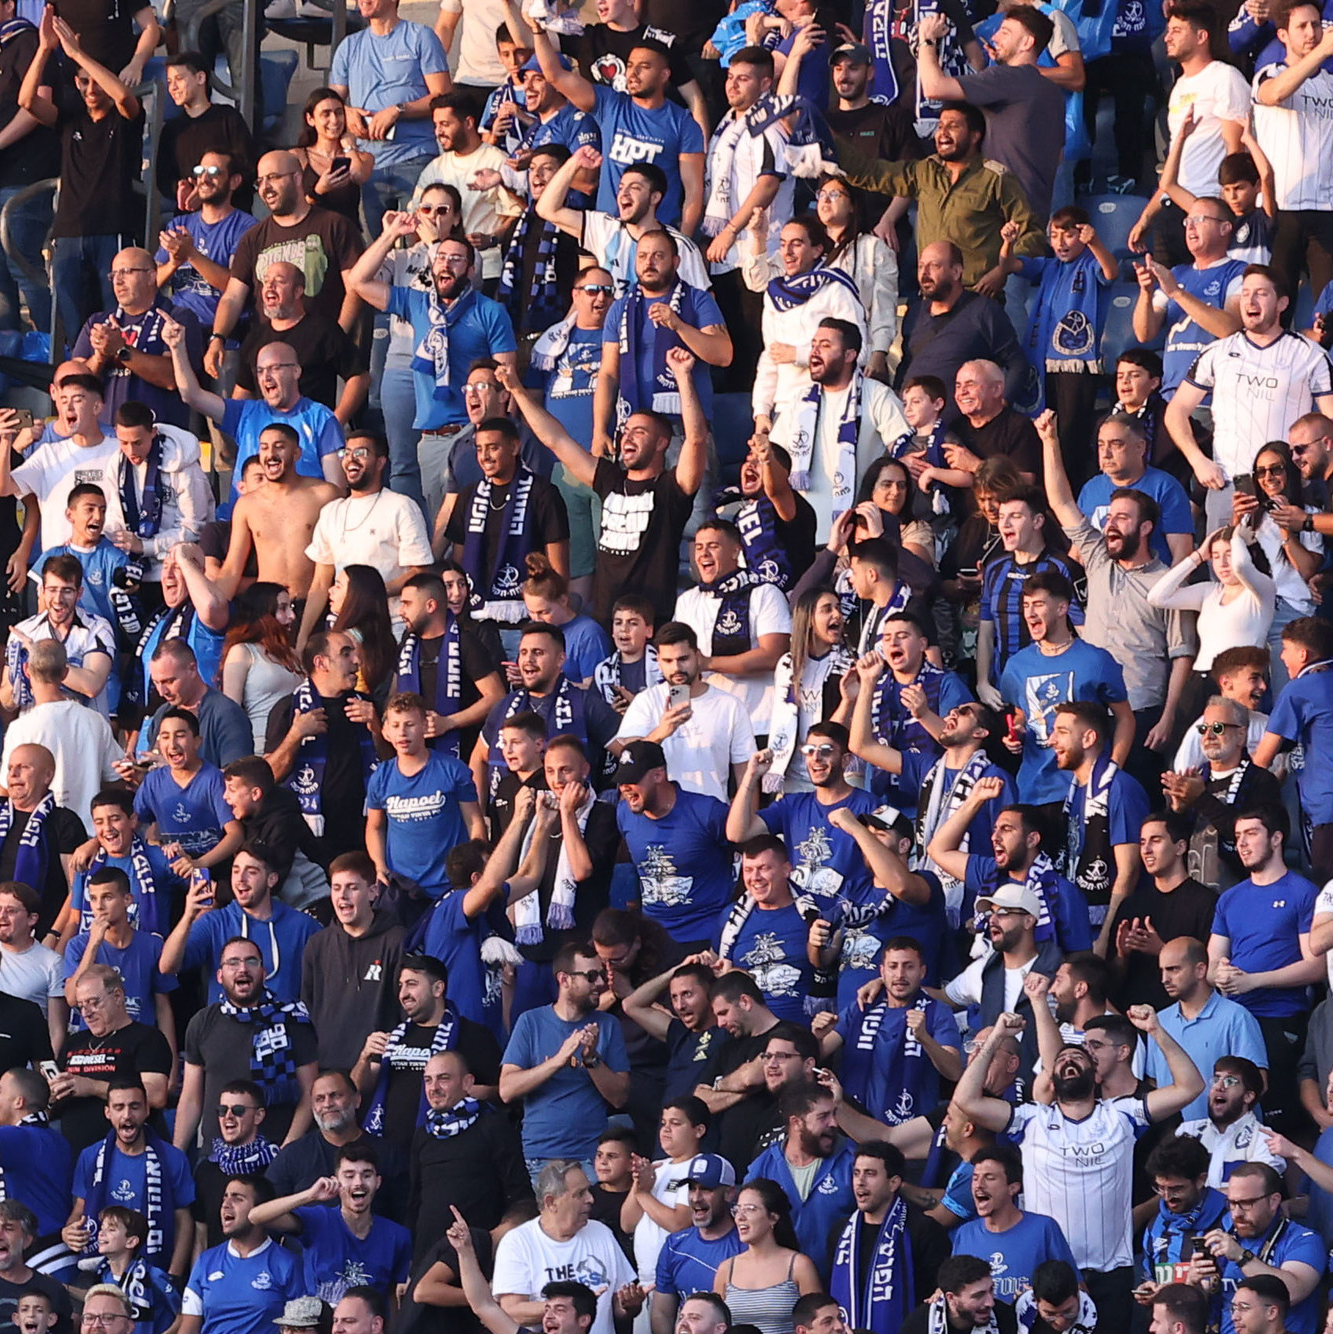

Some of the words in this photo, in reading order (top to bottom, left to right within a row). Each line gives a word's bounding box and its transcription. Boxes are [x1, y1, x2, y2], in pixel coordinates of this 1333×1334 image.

[1234, 374, 1276, 388] TWO
[1244, 388, 1271, 401] NIL
[386, 790, 445, 812] Hapoel
[1059, 1142, 1105, 1157] TWO
[1076, 1157, 1103, 1168] NIL
[545, 1263, 577, 1282] THE
